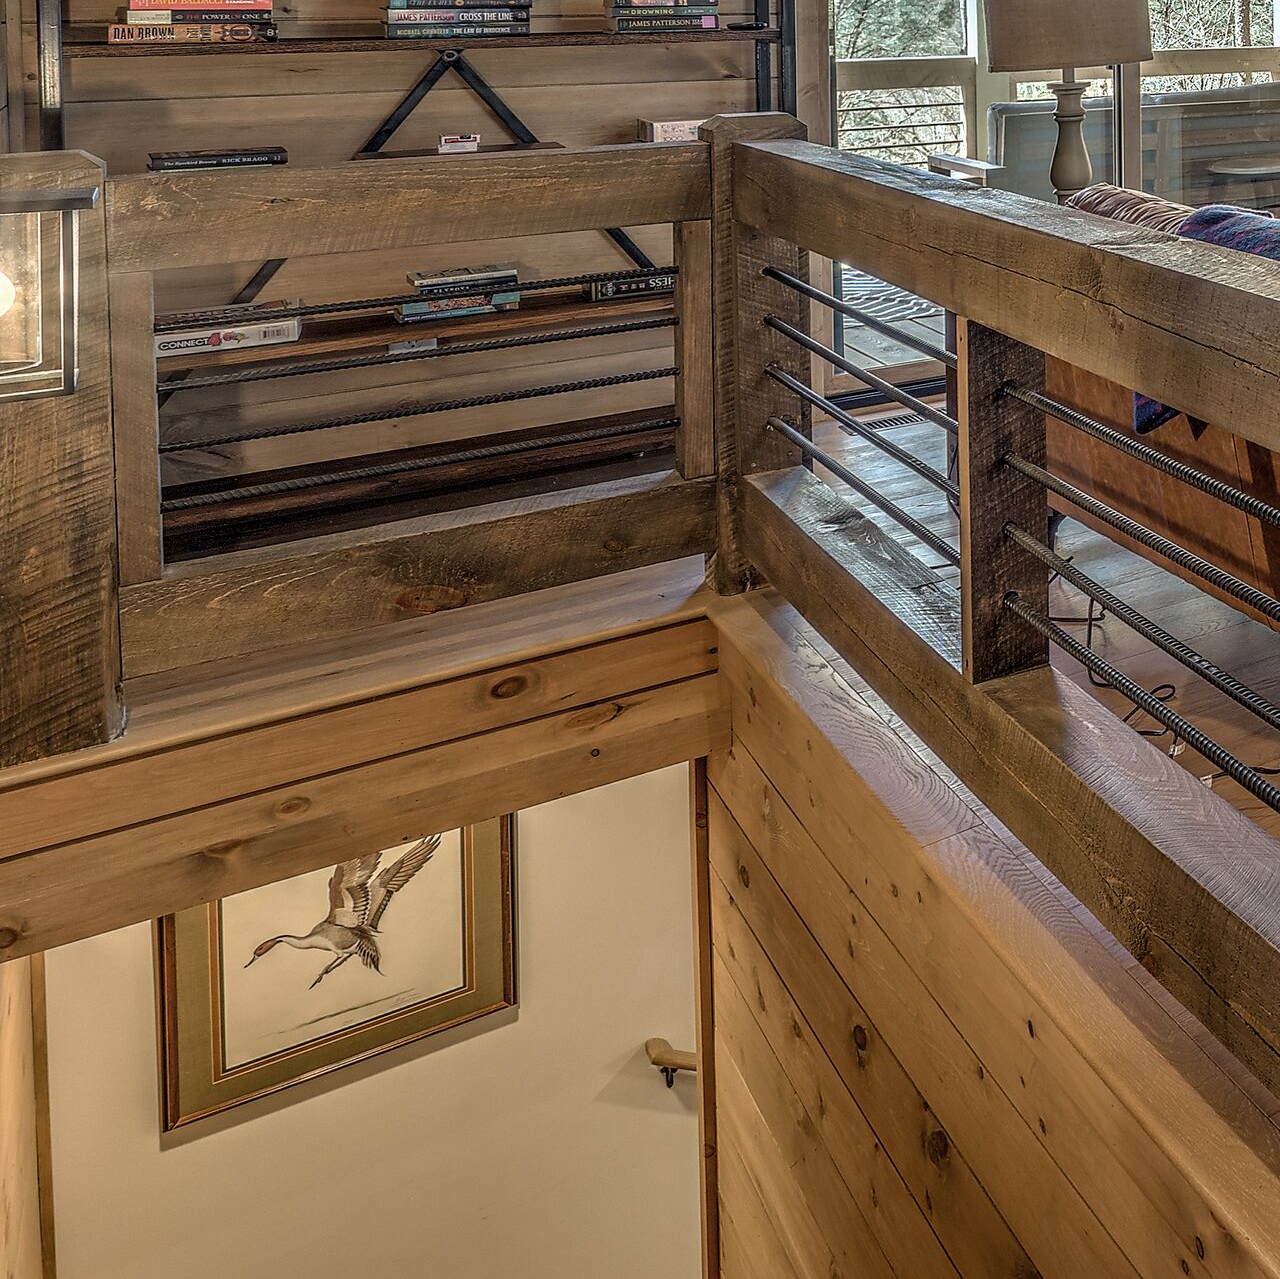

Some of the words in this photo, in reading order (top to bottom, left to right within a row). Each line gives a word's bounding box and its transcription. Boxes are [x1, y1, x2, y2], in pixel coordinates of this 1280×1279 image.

[395, 12, 417, 22] JAMES
[419, 12, 455, 21] PATTERSON
[459, 12, 482, 21] CROSS
[484, 12, 497, 21] THE
[498, 12, 514, 21] LINE
[629, 20, 650, 28] JAMES
[652, 19, 691, 27] PATTERSON
[113, 27, 134, 40] DAN
[138, 27, 175, 40] BROWN
[650, 277, 675, 289] HESS
[160, 337, 208, 350] CONNECT
[208, 333, 222, 347] 4
